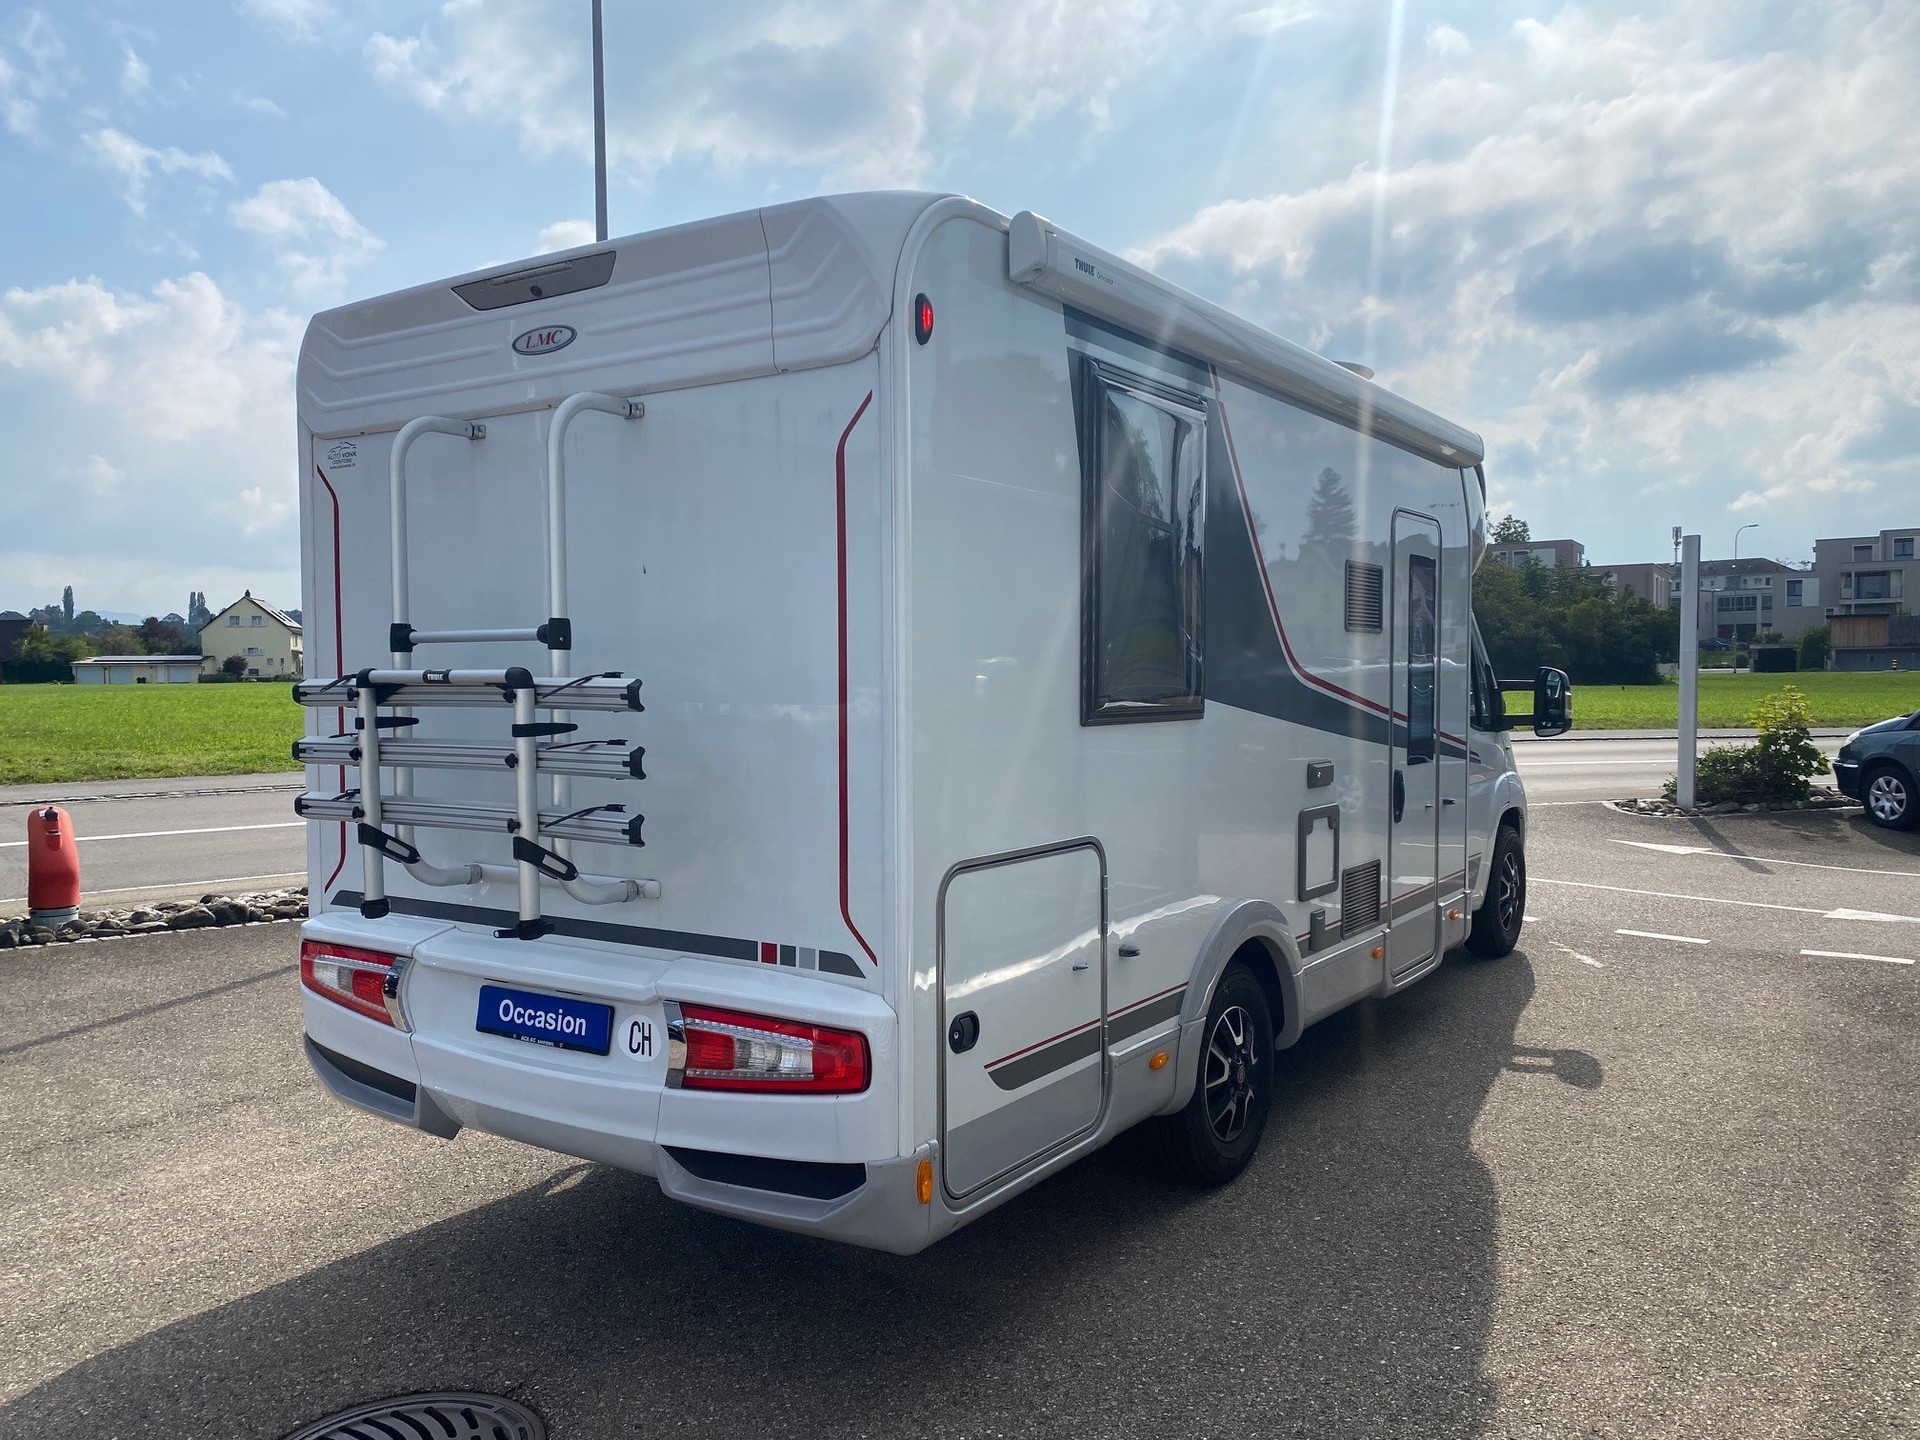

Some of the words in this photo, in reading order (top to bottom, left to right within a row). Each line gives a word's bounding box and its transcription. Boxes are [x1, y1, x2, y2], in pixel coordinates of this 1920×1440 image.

[1074, 257, 1096, 277] THULE
[525, 329, 563, 349] LMC
[498, 999, 587, 1036] Occasion
[628, 1020, 652, 1057] CH
